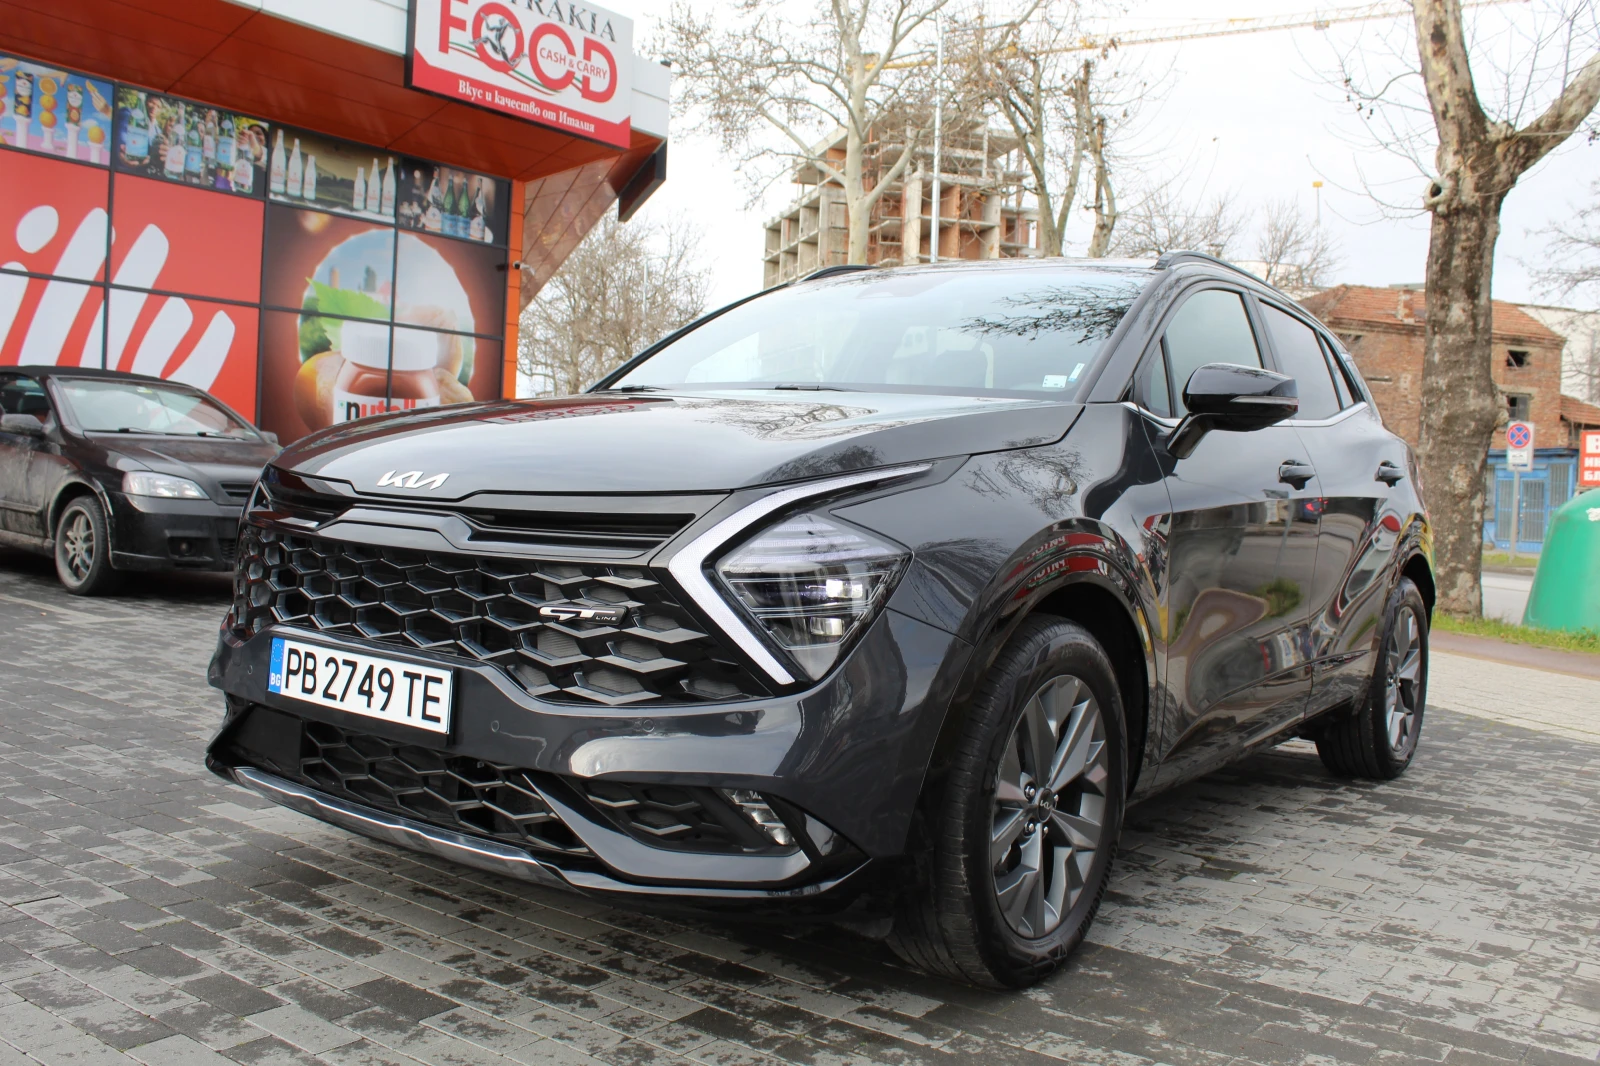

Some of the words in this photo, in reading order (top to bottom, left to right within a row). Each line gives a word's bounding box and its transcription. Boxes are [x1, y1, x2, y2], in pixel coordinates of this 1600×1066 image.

[540, 47, 567, 66] CASH
[568, 59, 575, 69] &
[576, 60, 607, 80] CARRY
[458, 79, 483, 101] Вкус
[485, 91, 492, 102] и
[495, 90, 541, 116] качество
[542, 109, 557, 121] от
[559, 110, 595, 133] Италия
[376, 470, 450, 490] KIA
[270, 672, 281, 686] BG
